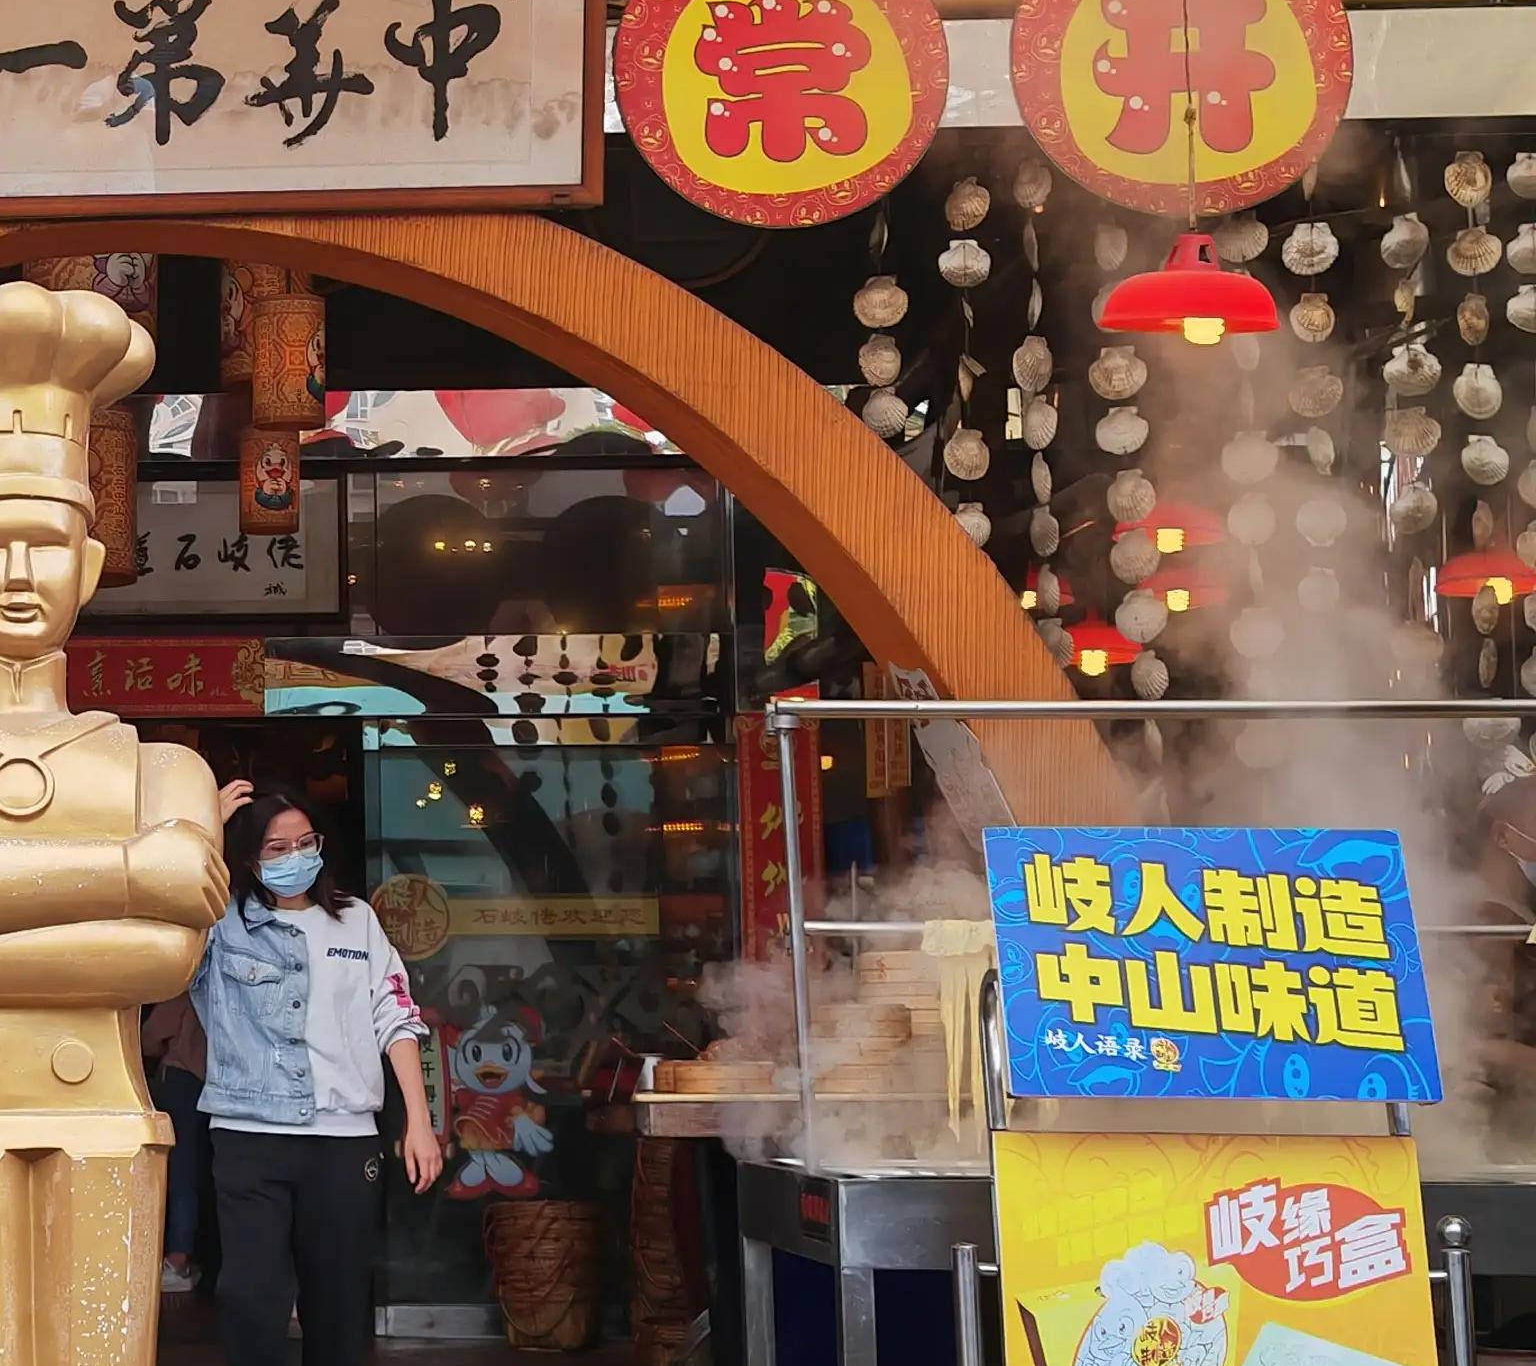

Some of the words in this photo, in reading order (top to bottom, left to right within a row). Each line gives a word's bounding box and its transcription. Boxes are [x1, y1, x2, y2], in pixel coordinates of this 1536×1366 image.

[1024, 853, 1391, 961] 岐人制造
[327, 948, 369, 961] EMOTION
[1035, 943, 1407, 1053] 中山味道
[1045, 1029, 1148, 1062] 岐人语录
